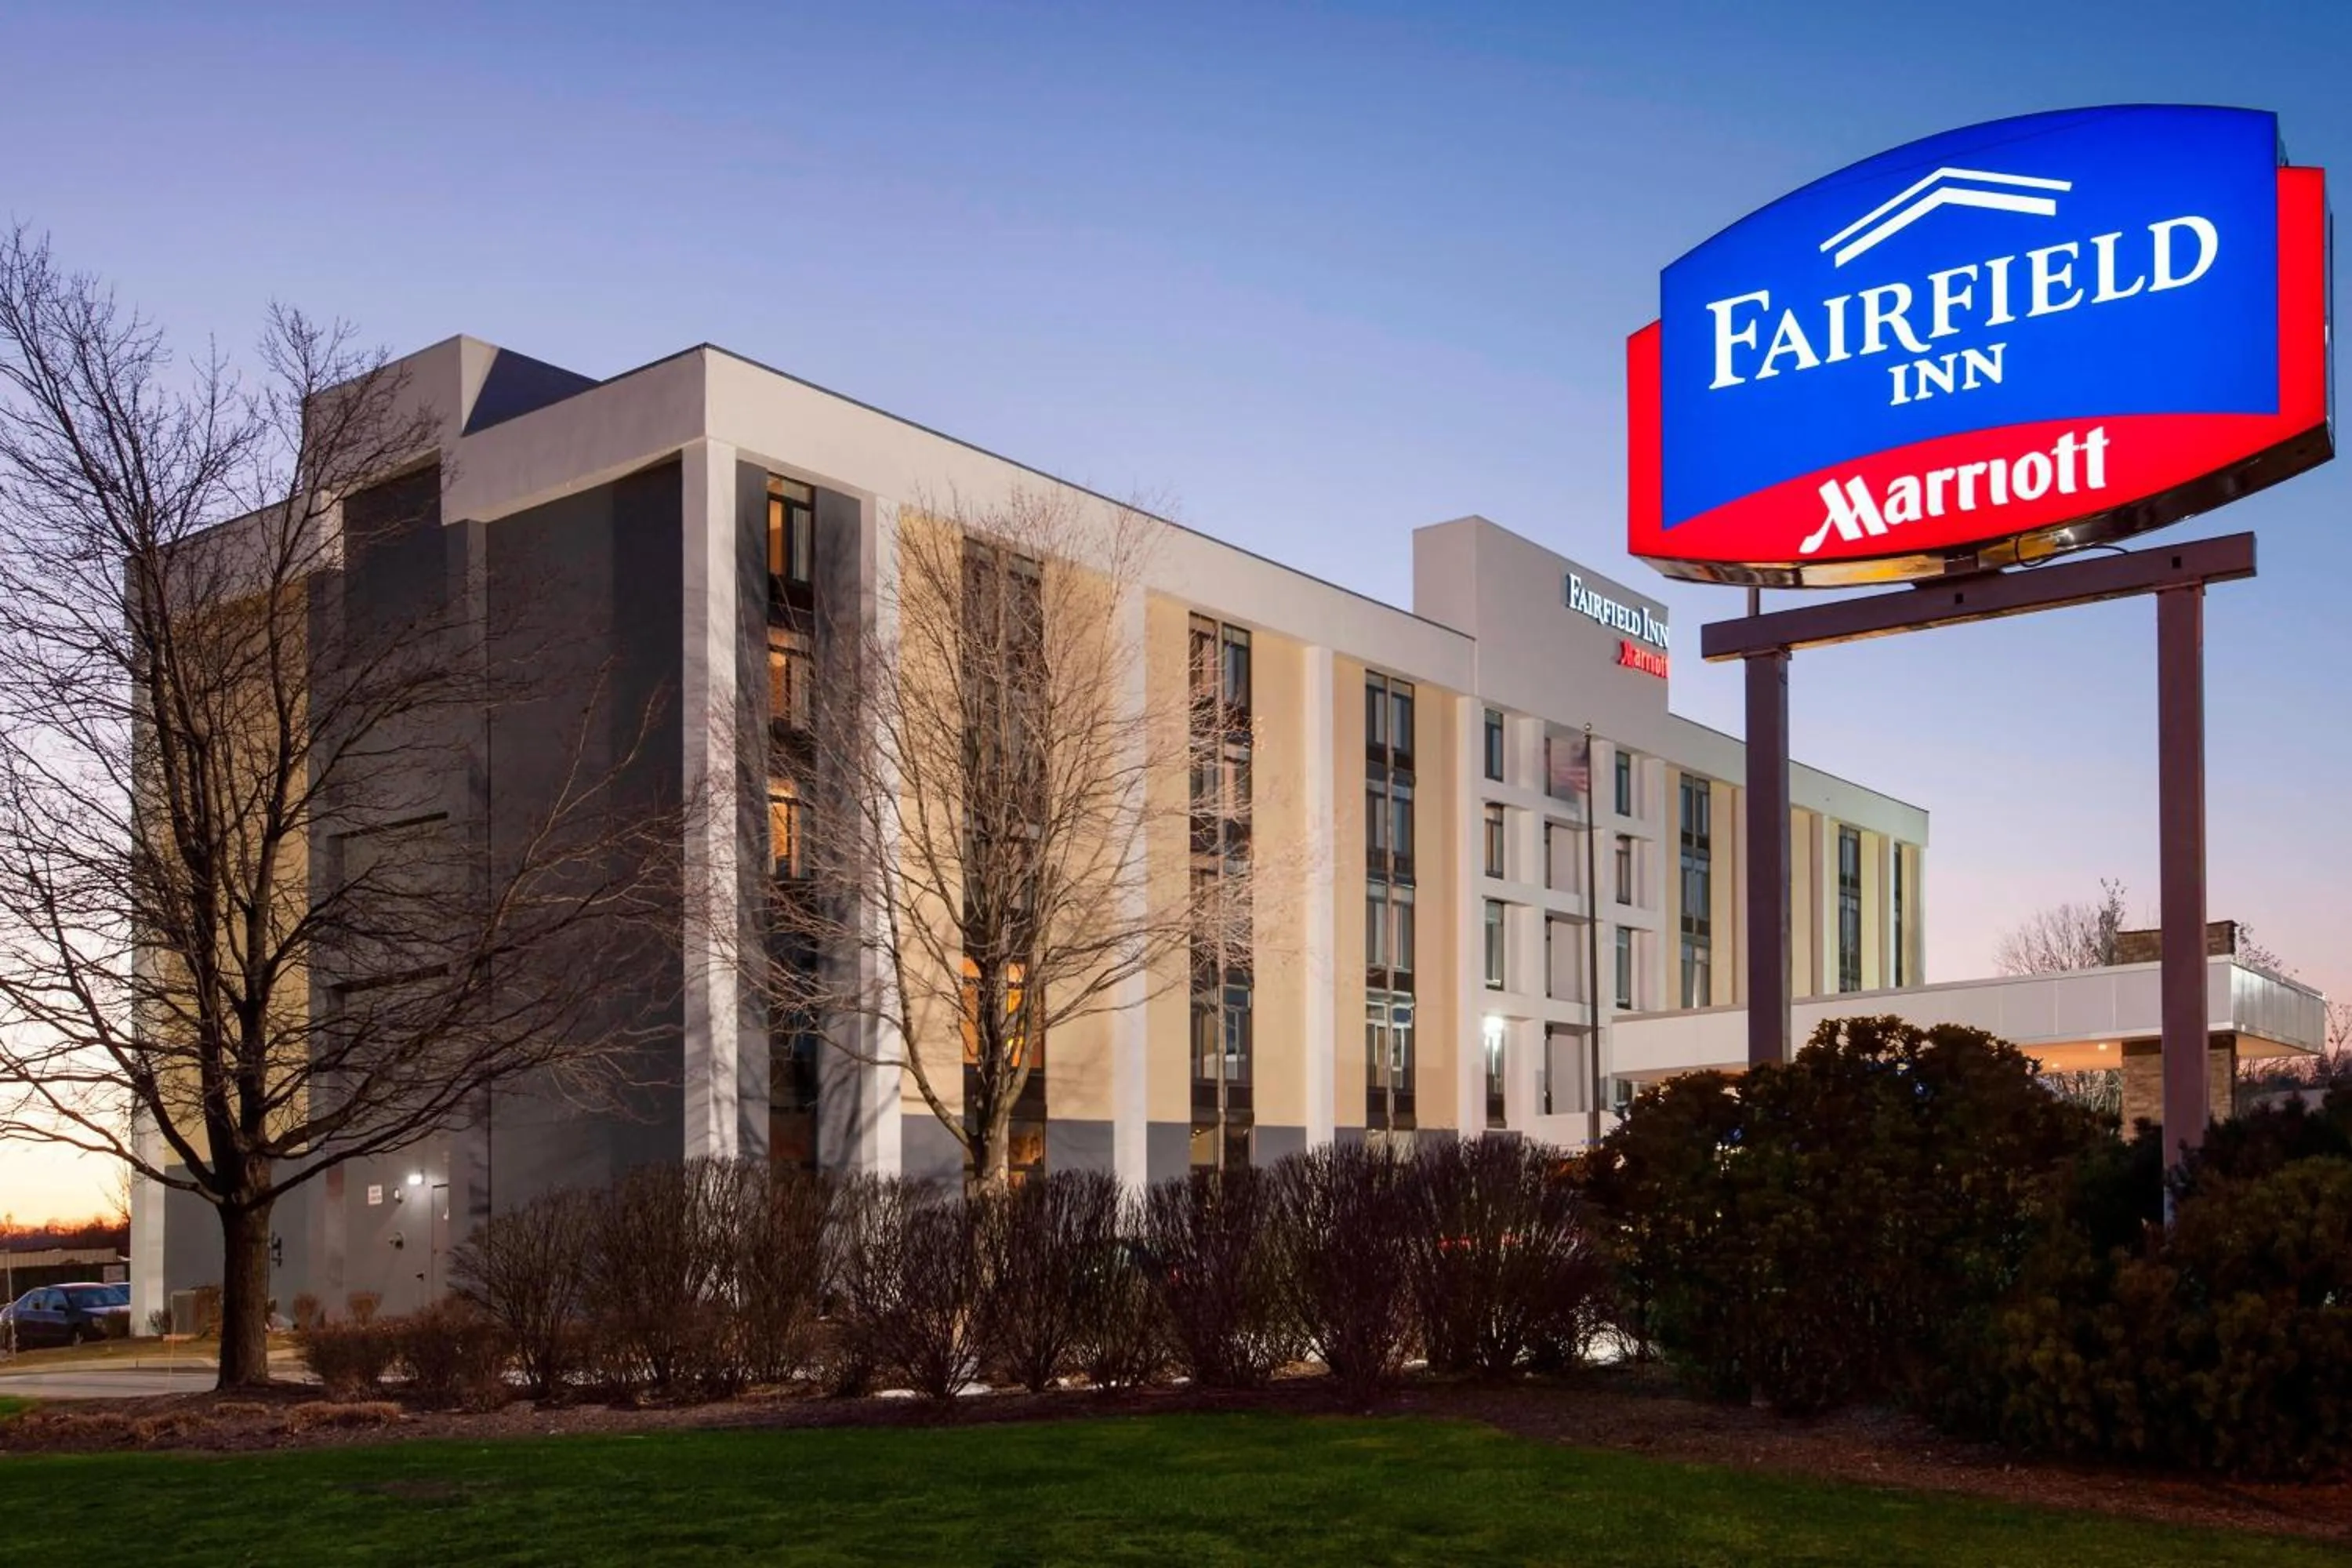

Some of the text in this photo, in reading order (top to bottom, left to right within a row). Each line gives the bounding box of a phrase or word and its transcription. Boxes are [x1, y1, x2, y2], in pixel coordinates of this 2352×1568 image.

[1706, 216, 2219, 390] FAIRFIELD
[1889, 343, 2006, 406] INN
[1799, 426, 2111, 554] Marriott
[1569, 572, 1669, 648] FAIRFIELD INN
